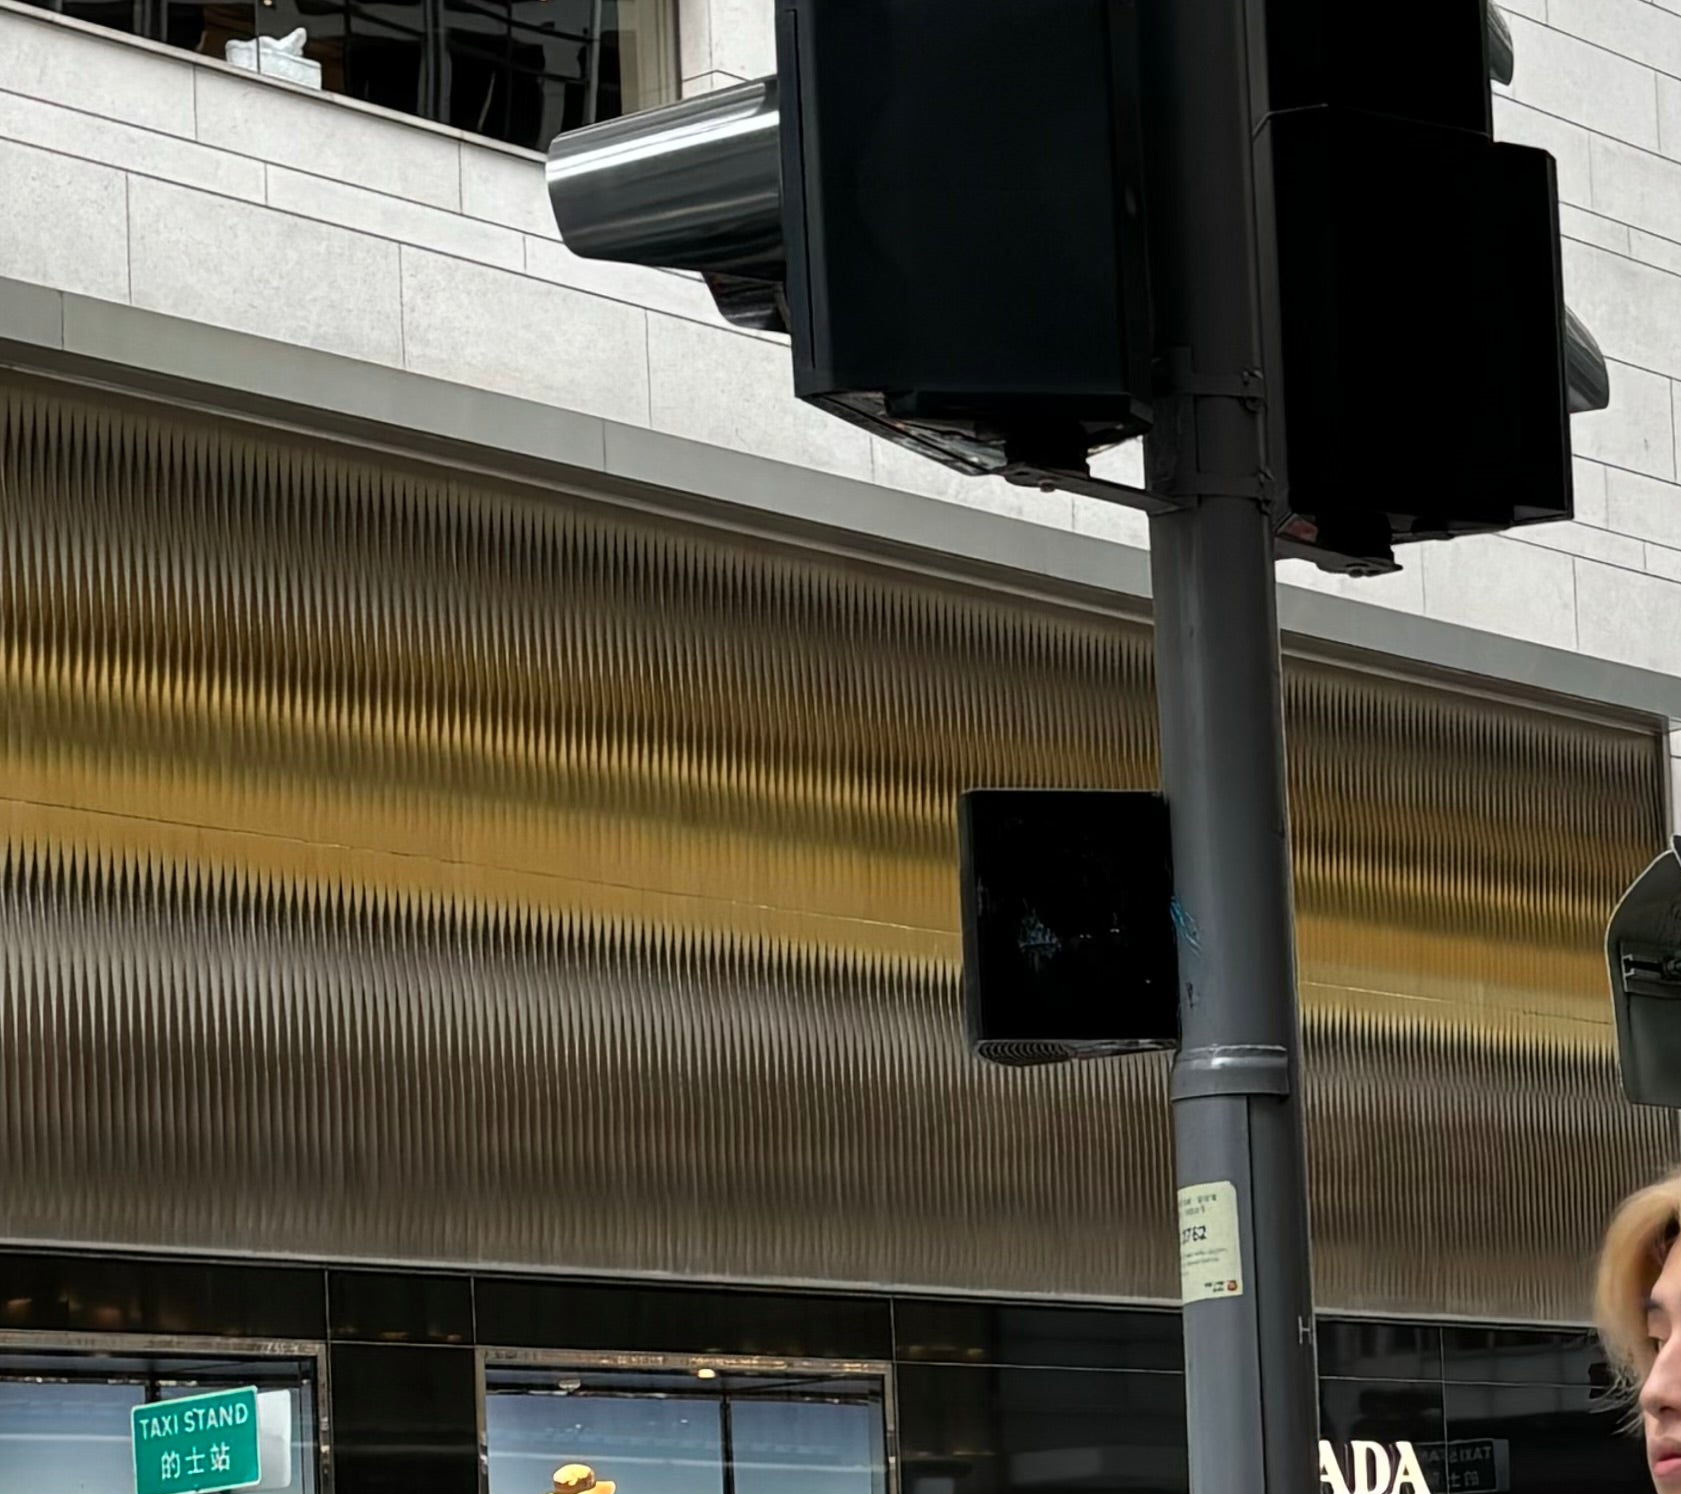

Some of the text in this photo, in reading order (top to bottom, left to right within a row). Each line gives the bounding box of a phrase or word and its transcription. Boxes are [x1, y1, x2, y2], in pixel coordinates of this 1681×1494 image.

[139, 1403, 249, 1440] TAXI STAND
[161, 1441, 231, 1480] 的士站
